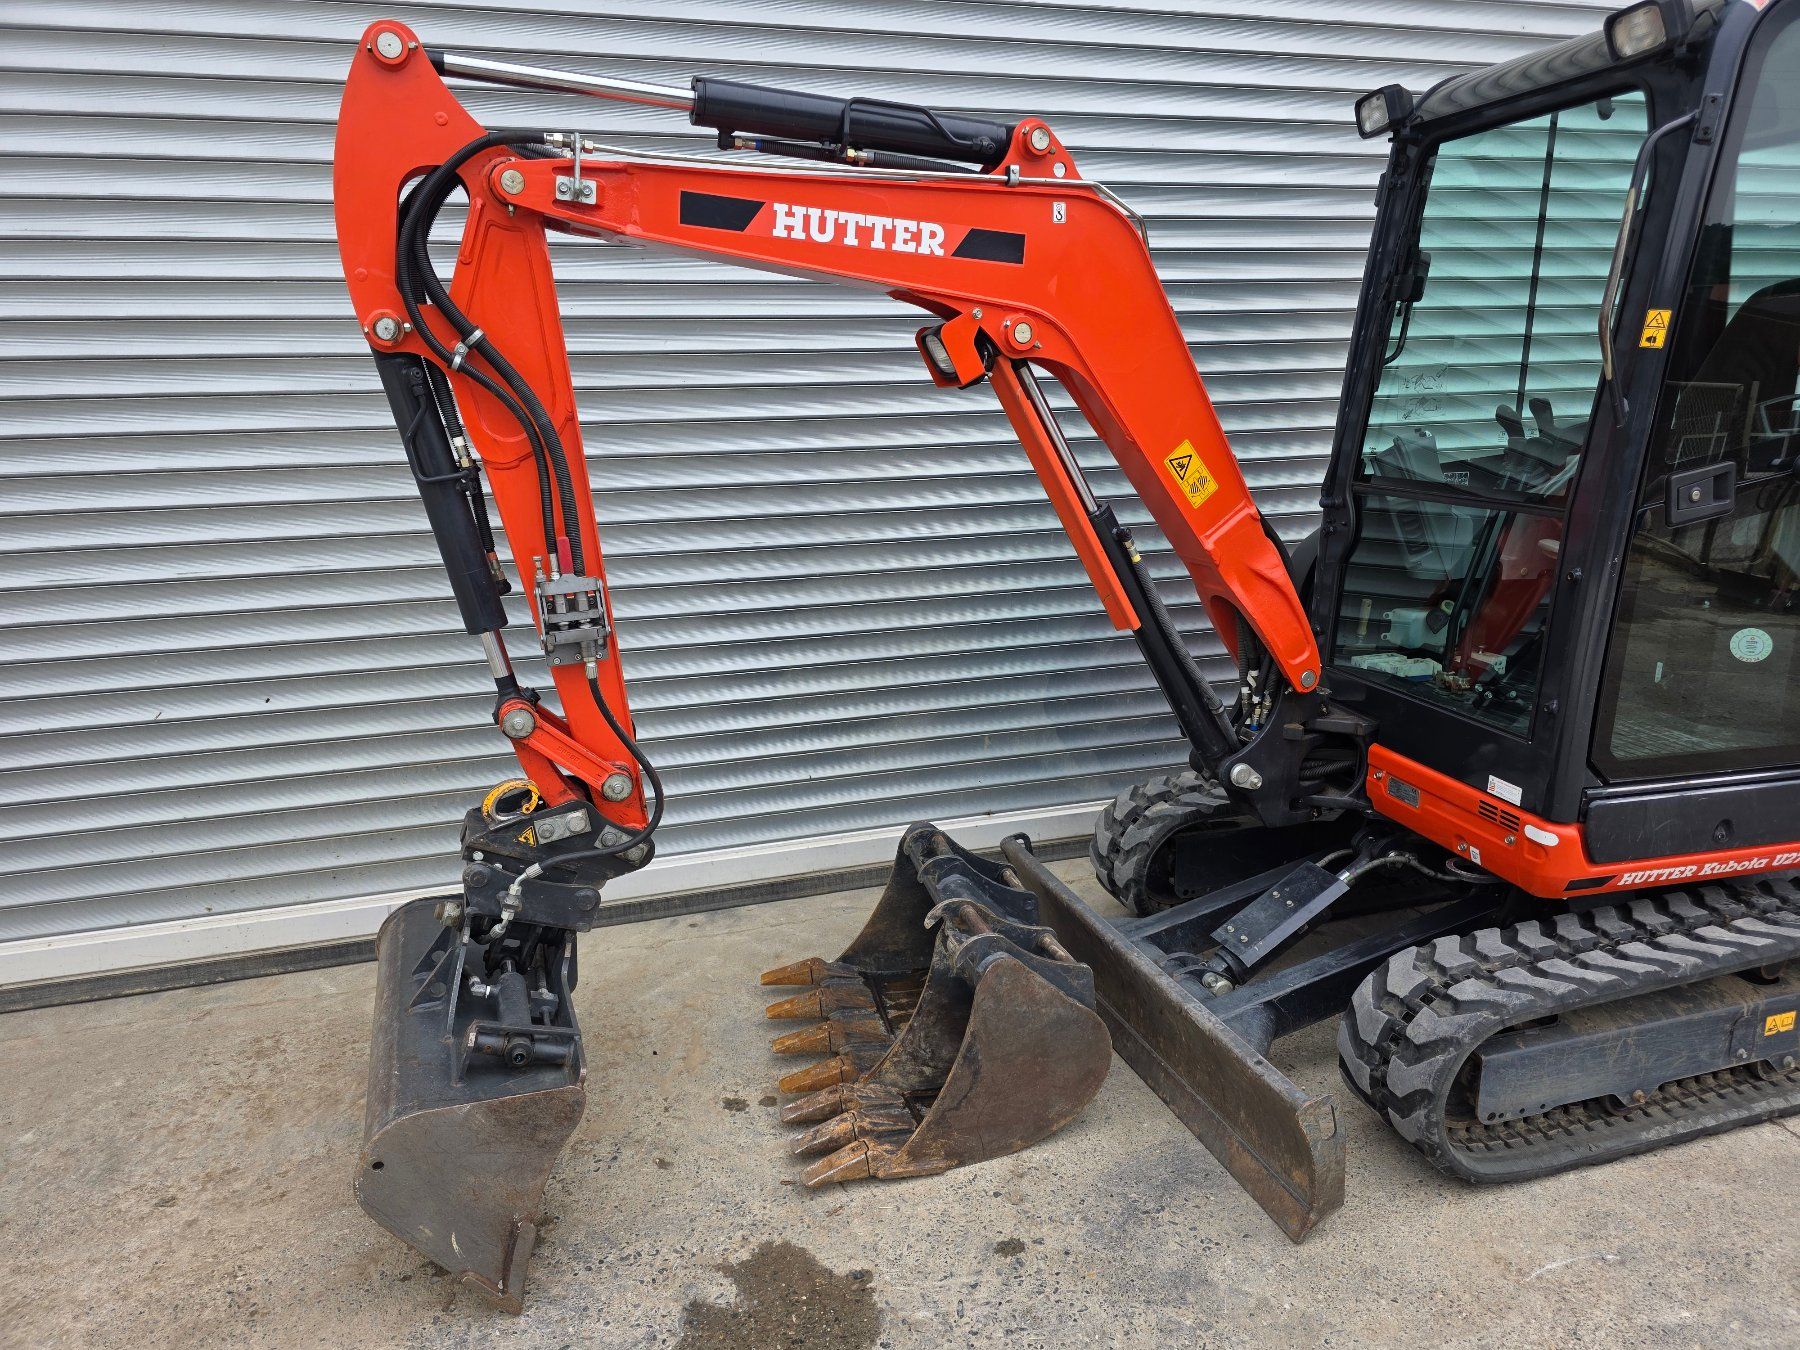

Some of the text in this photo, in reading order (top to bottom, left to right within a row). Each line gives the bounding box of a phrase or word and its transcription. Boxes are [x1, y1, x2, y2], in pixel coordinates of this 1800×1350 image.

[772, 202, 945, 257] HUTTER
[1616, 865, 1698, 886] HUTTER
[1698, 857, 1769, 877] Kubota
